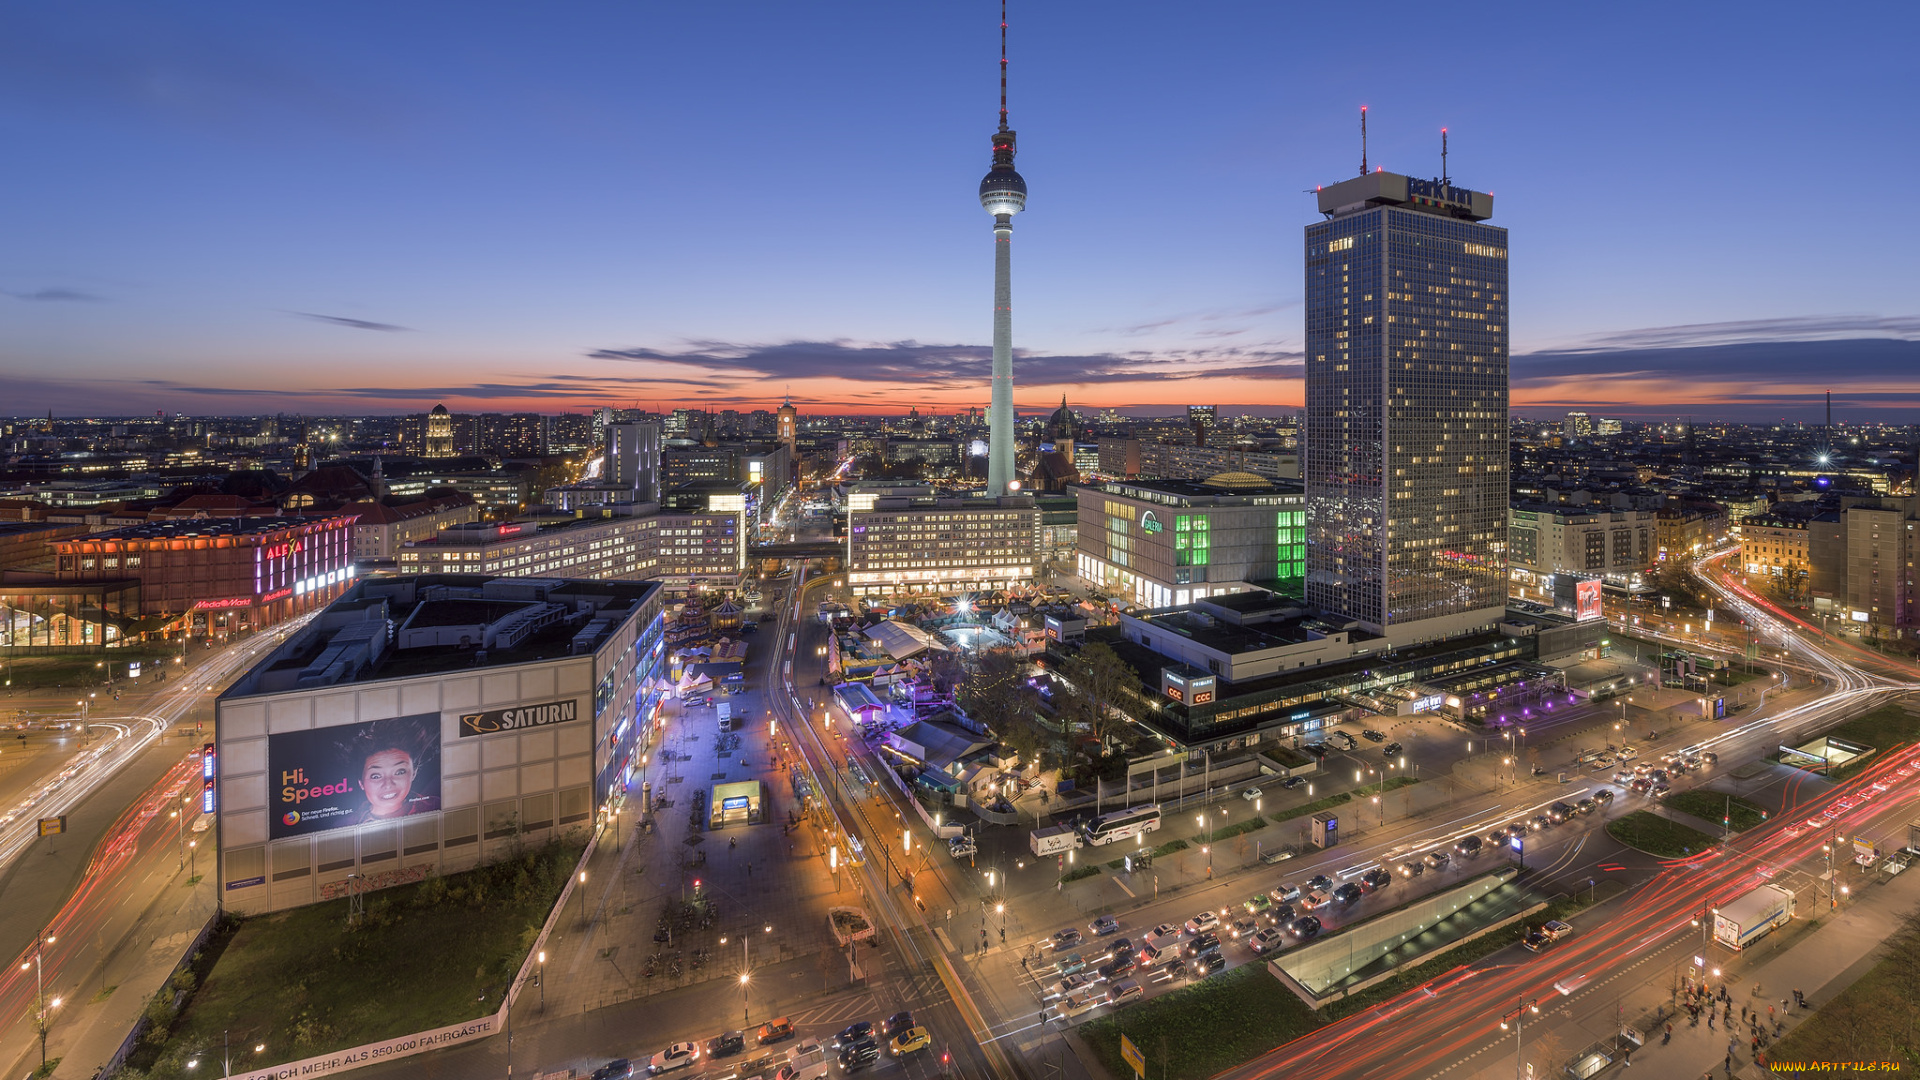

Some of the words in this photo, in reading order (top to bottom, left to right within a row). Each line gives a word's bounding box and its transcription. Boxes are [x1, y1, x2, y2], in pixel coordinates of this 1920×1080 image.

[1408, 176, 1446, 201] park
[1447, 180, 1472, 206] inn
[266, 538, 302, 562] ALEXA
[1168, 687, 1182, 700] CCC
[1195, 692, 1211, 703] CCC
[502, 702, 574, 730] SATURN
[282, 767, 309, 786] Hi,
[281, 778, 353, 804] Speed.
[302, 1058, 340, 1075] MEHR
[343, 1051, 369, 1065] ALS
[371, 1040, 417, 1059] 350.000
[419, 1021, 491, 1047] FAHRGÄSTE
